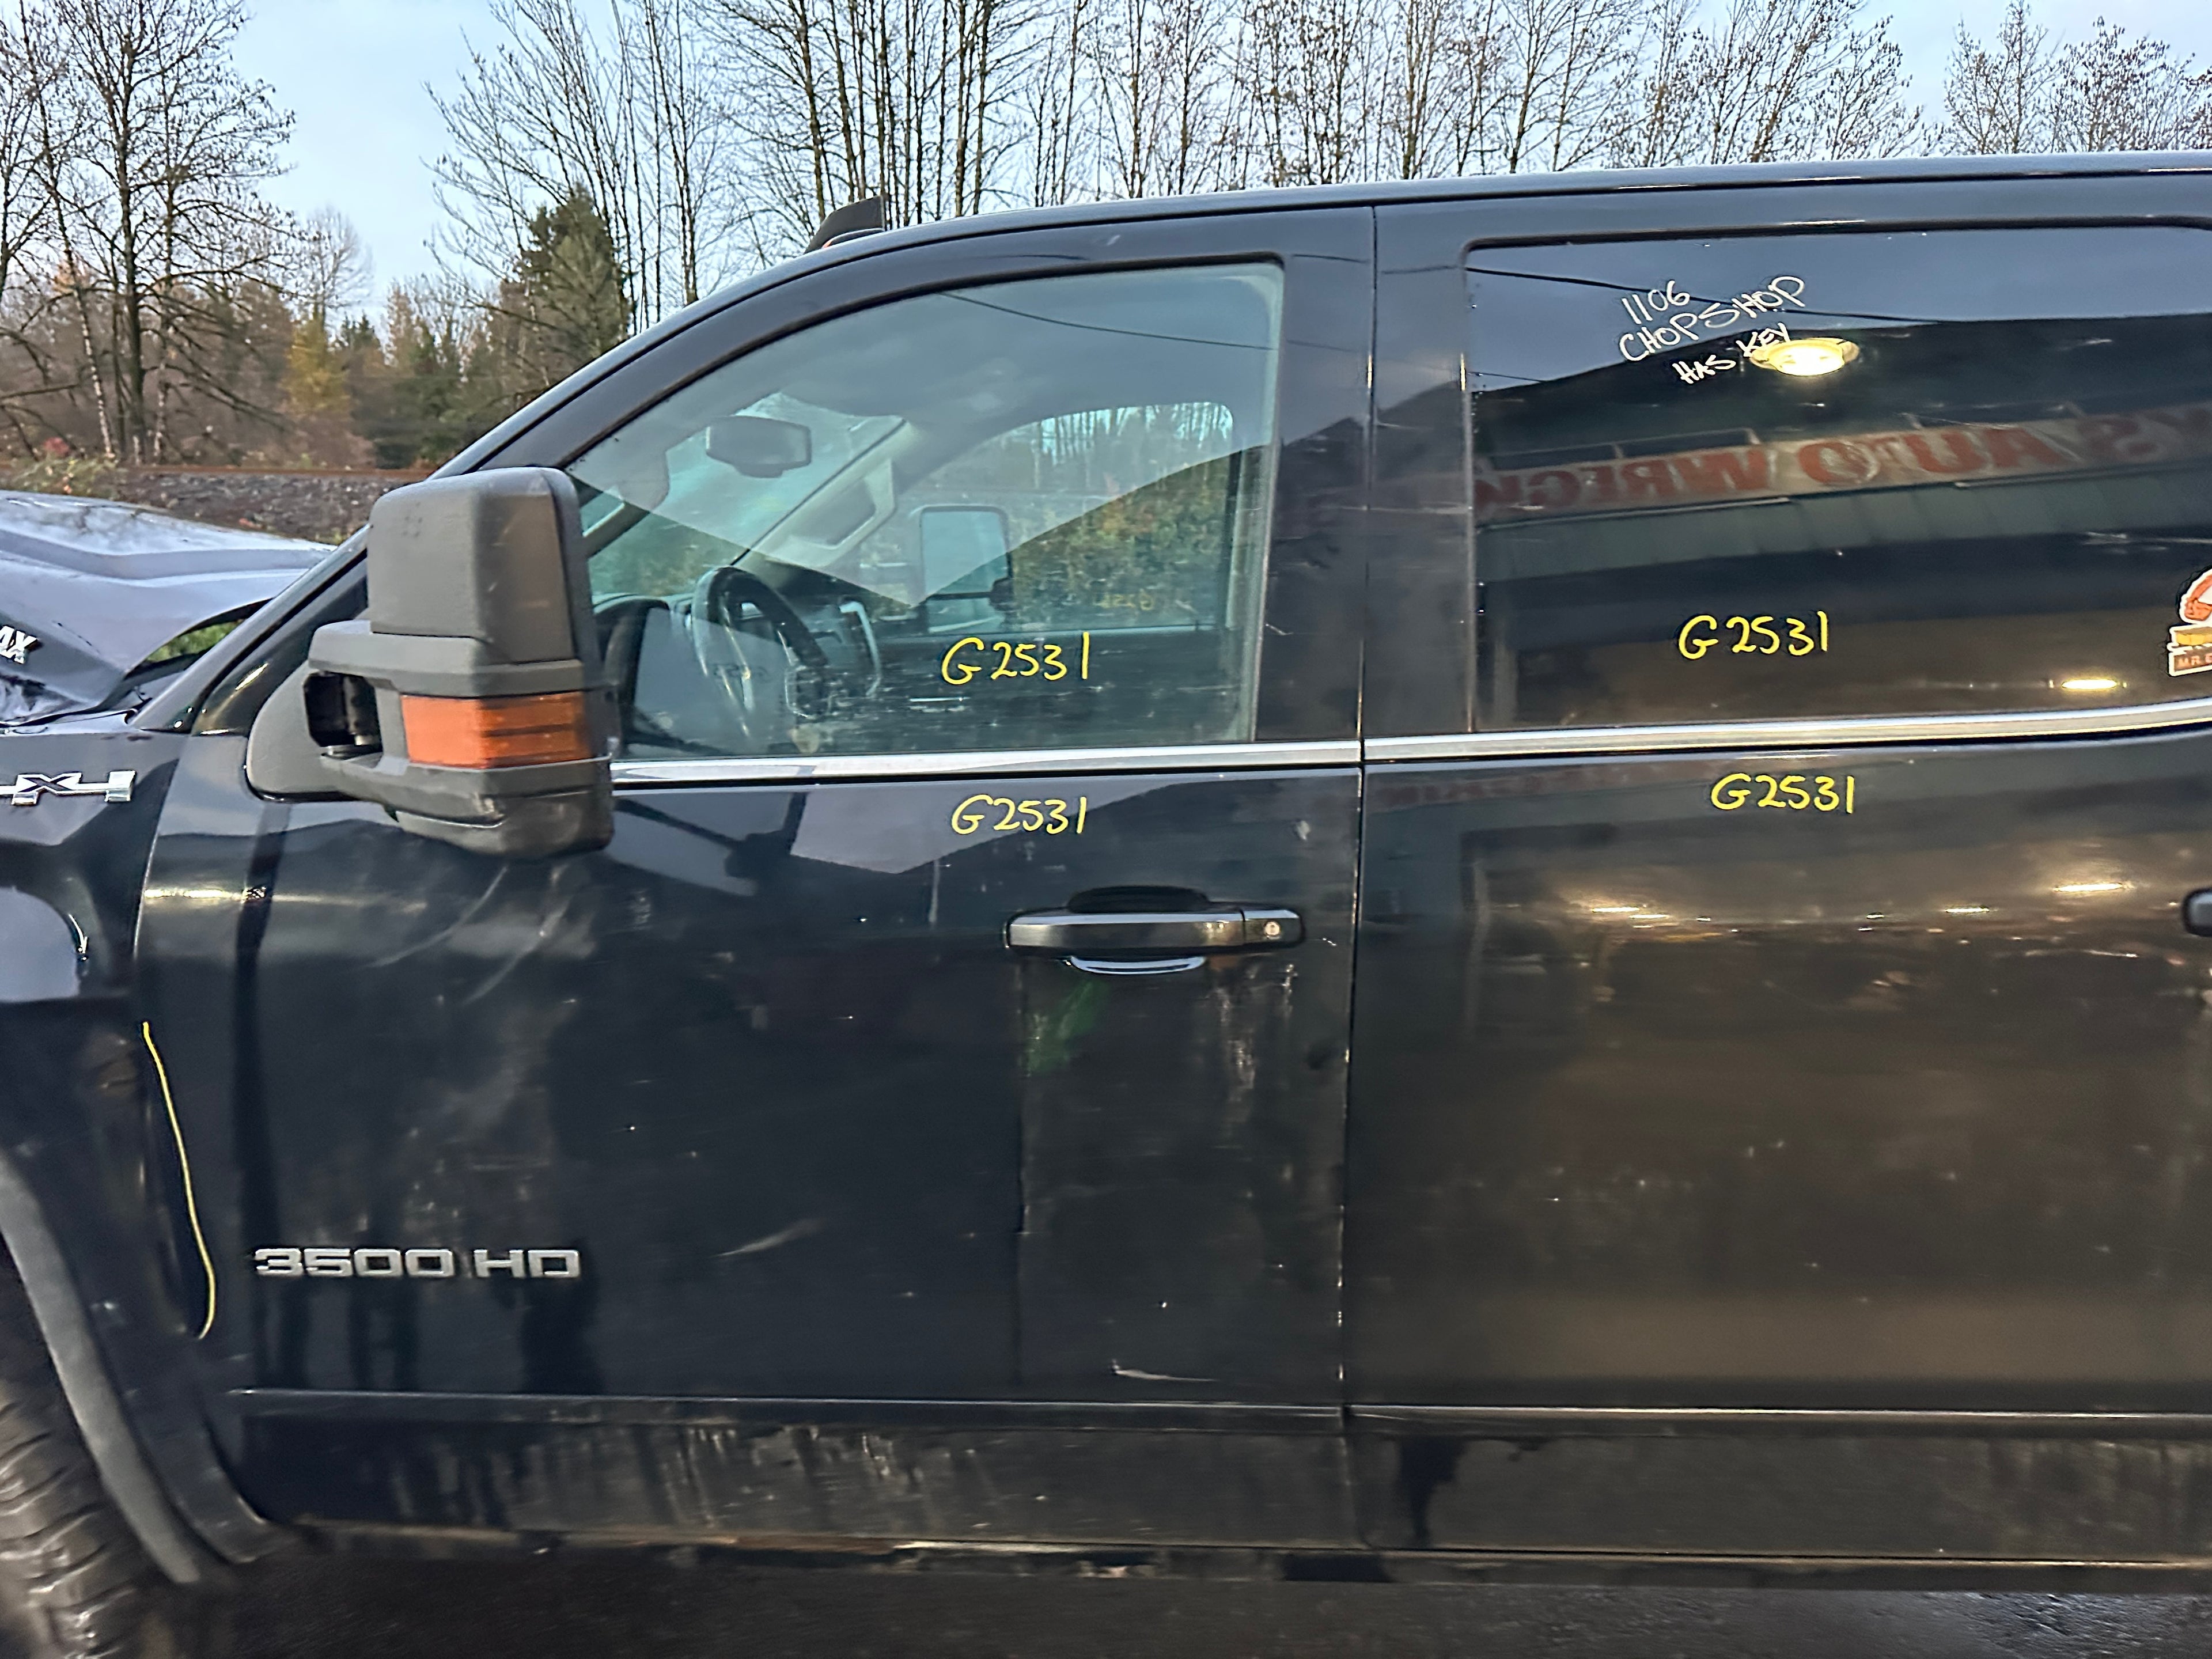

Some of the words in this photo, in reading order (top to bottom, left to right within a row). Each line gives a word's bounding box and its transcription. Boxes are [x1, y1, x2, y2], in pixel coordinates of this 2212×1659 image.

[1622, 279, 1690, 324] 1106
[1672, 354, 1737, 385] HAS
[1736, 321, 1791, 358] KEY
[1678, 610, 1829, 660] G2531
[941, 631, 1090, 685] G2531
[951, 794, 1087, 835] G2531
[1710, 772, 1854, 814] G2531
[255, 1247, 456, 1278] 3500
[473, 1248, 581, 1278] HD
